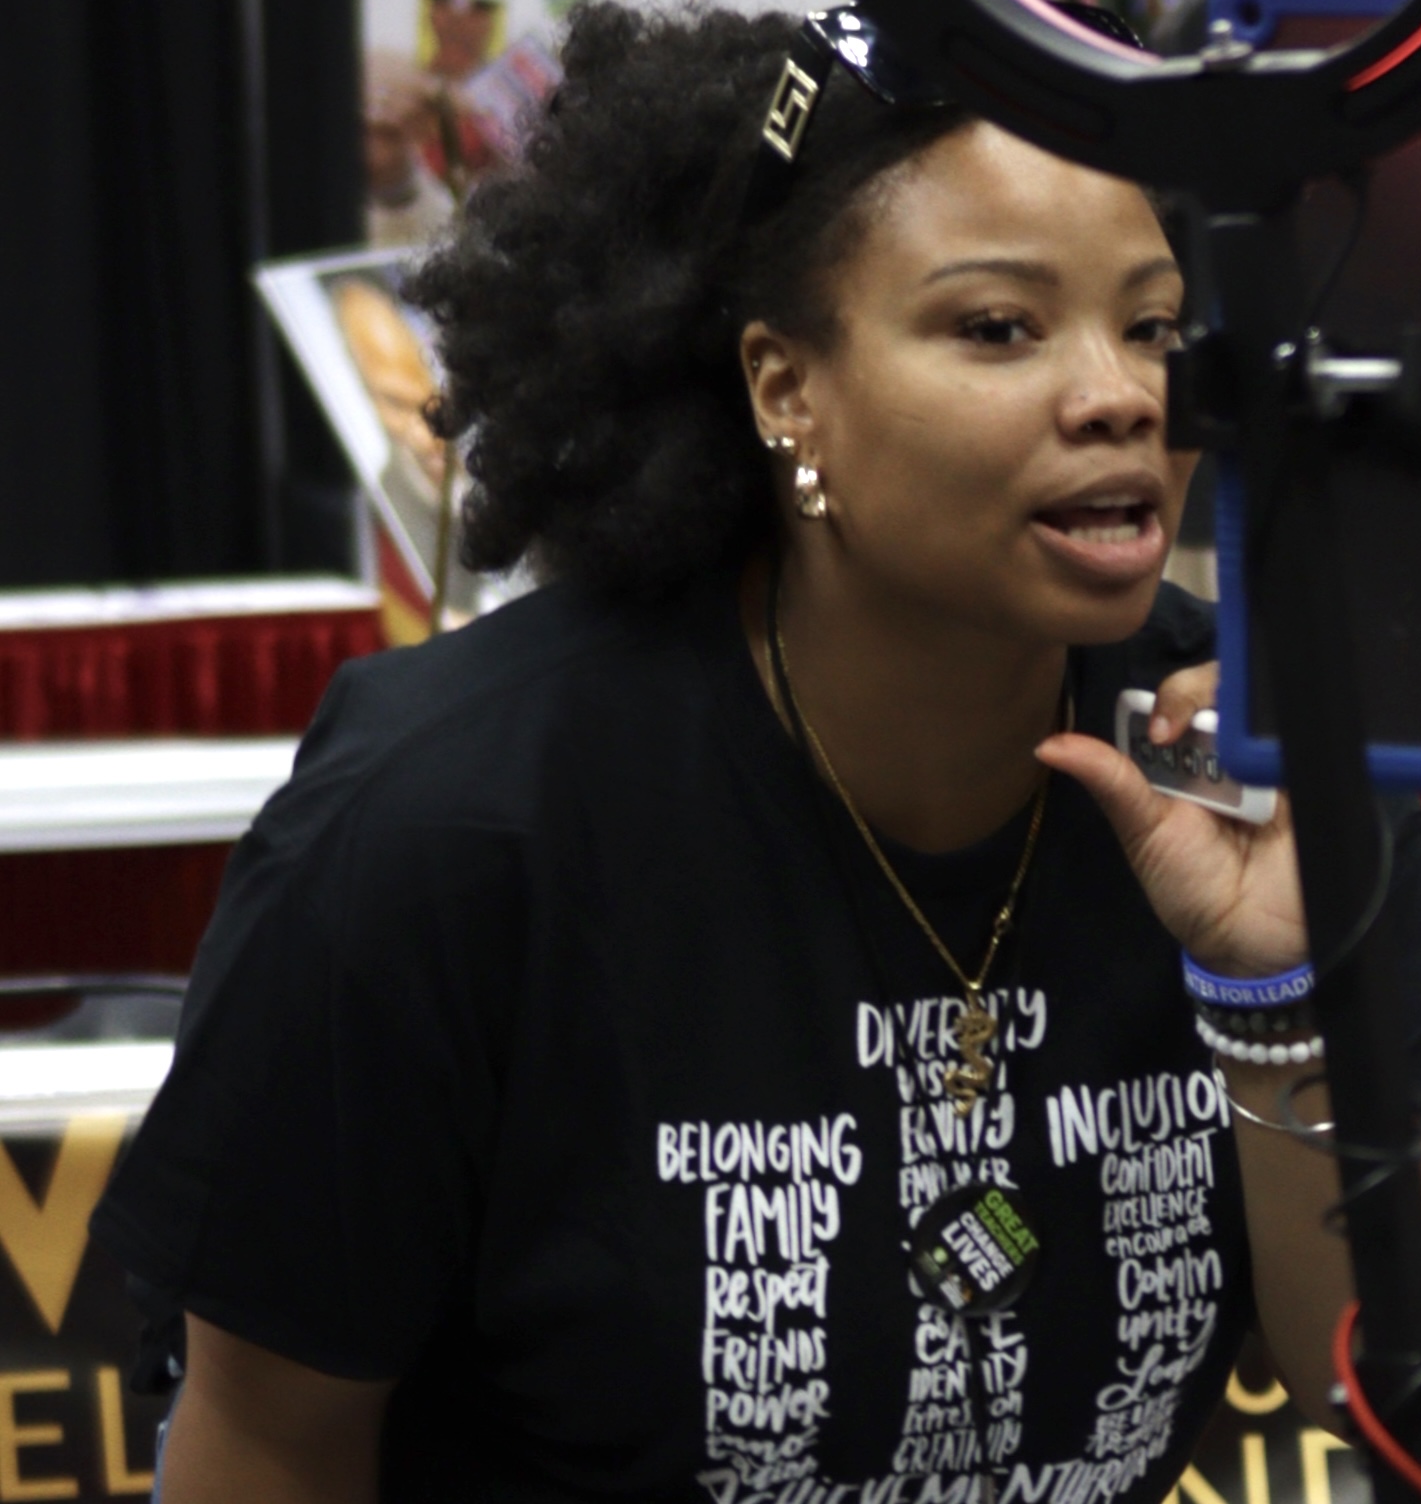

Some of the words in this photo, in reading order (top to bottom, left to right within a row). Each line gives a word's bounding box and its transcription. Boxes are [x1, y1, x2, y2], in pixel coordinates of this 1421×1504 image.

[856, 986, 1047, 1068] DIVERITY
[656, 1112, 863, 1186] BELONGING
[704, 1178, 841, 1267] FAMILY
[941, 1220, 1000, 1292] LIVES
[959, 1211, 1014, 1278] CHANGE
[985, 1189, 1039, 1255] GREAT
[909, 1345, 1028, 1404] IDENITY
[892, 1417, 1023, 1474] CREATIITY
